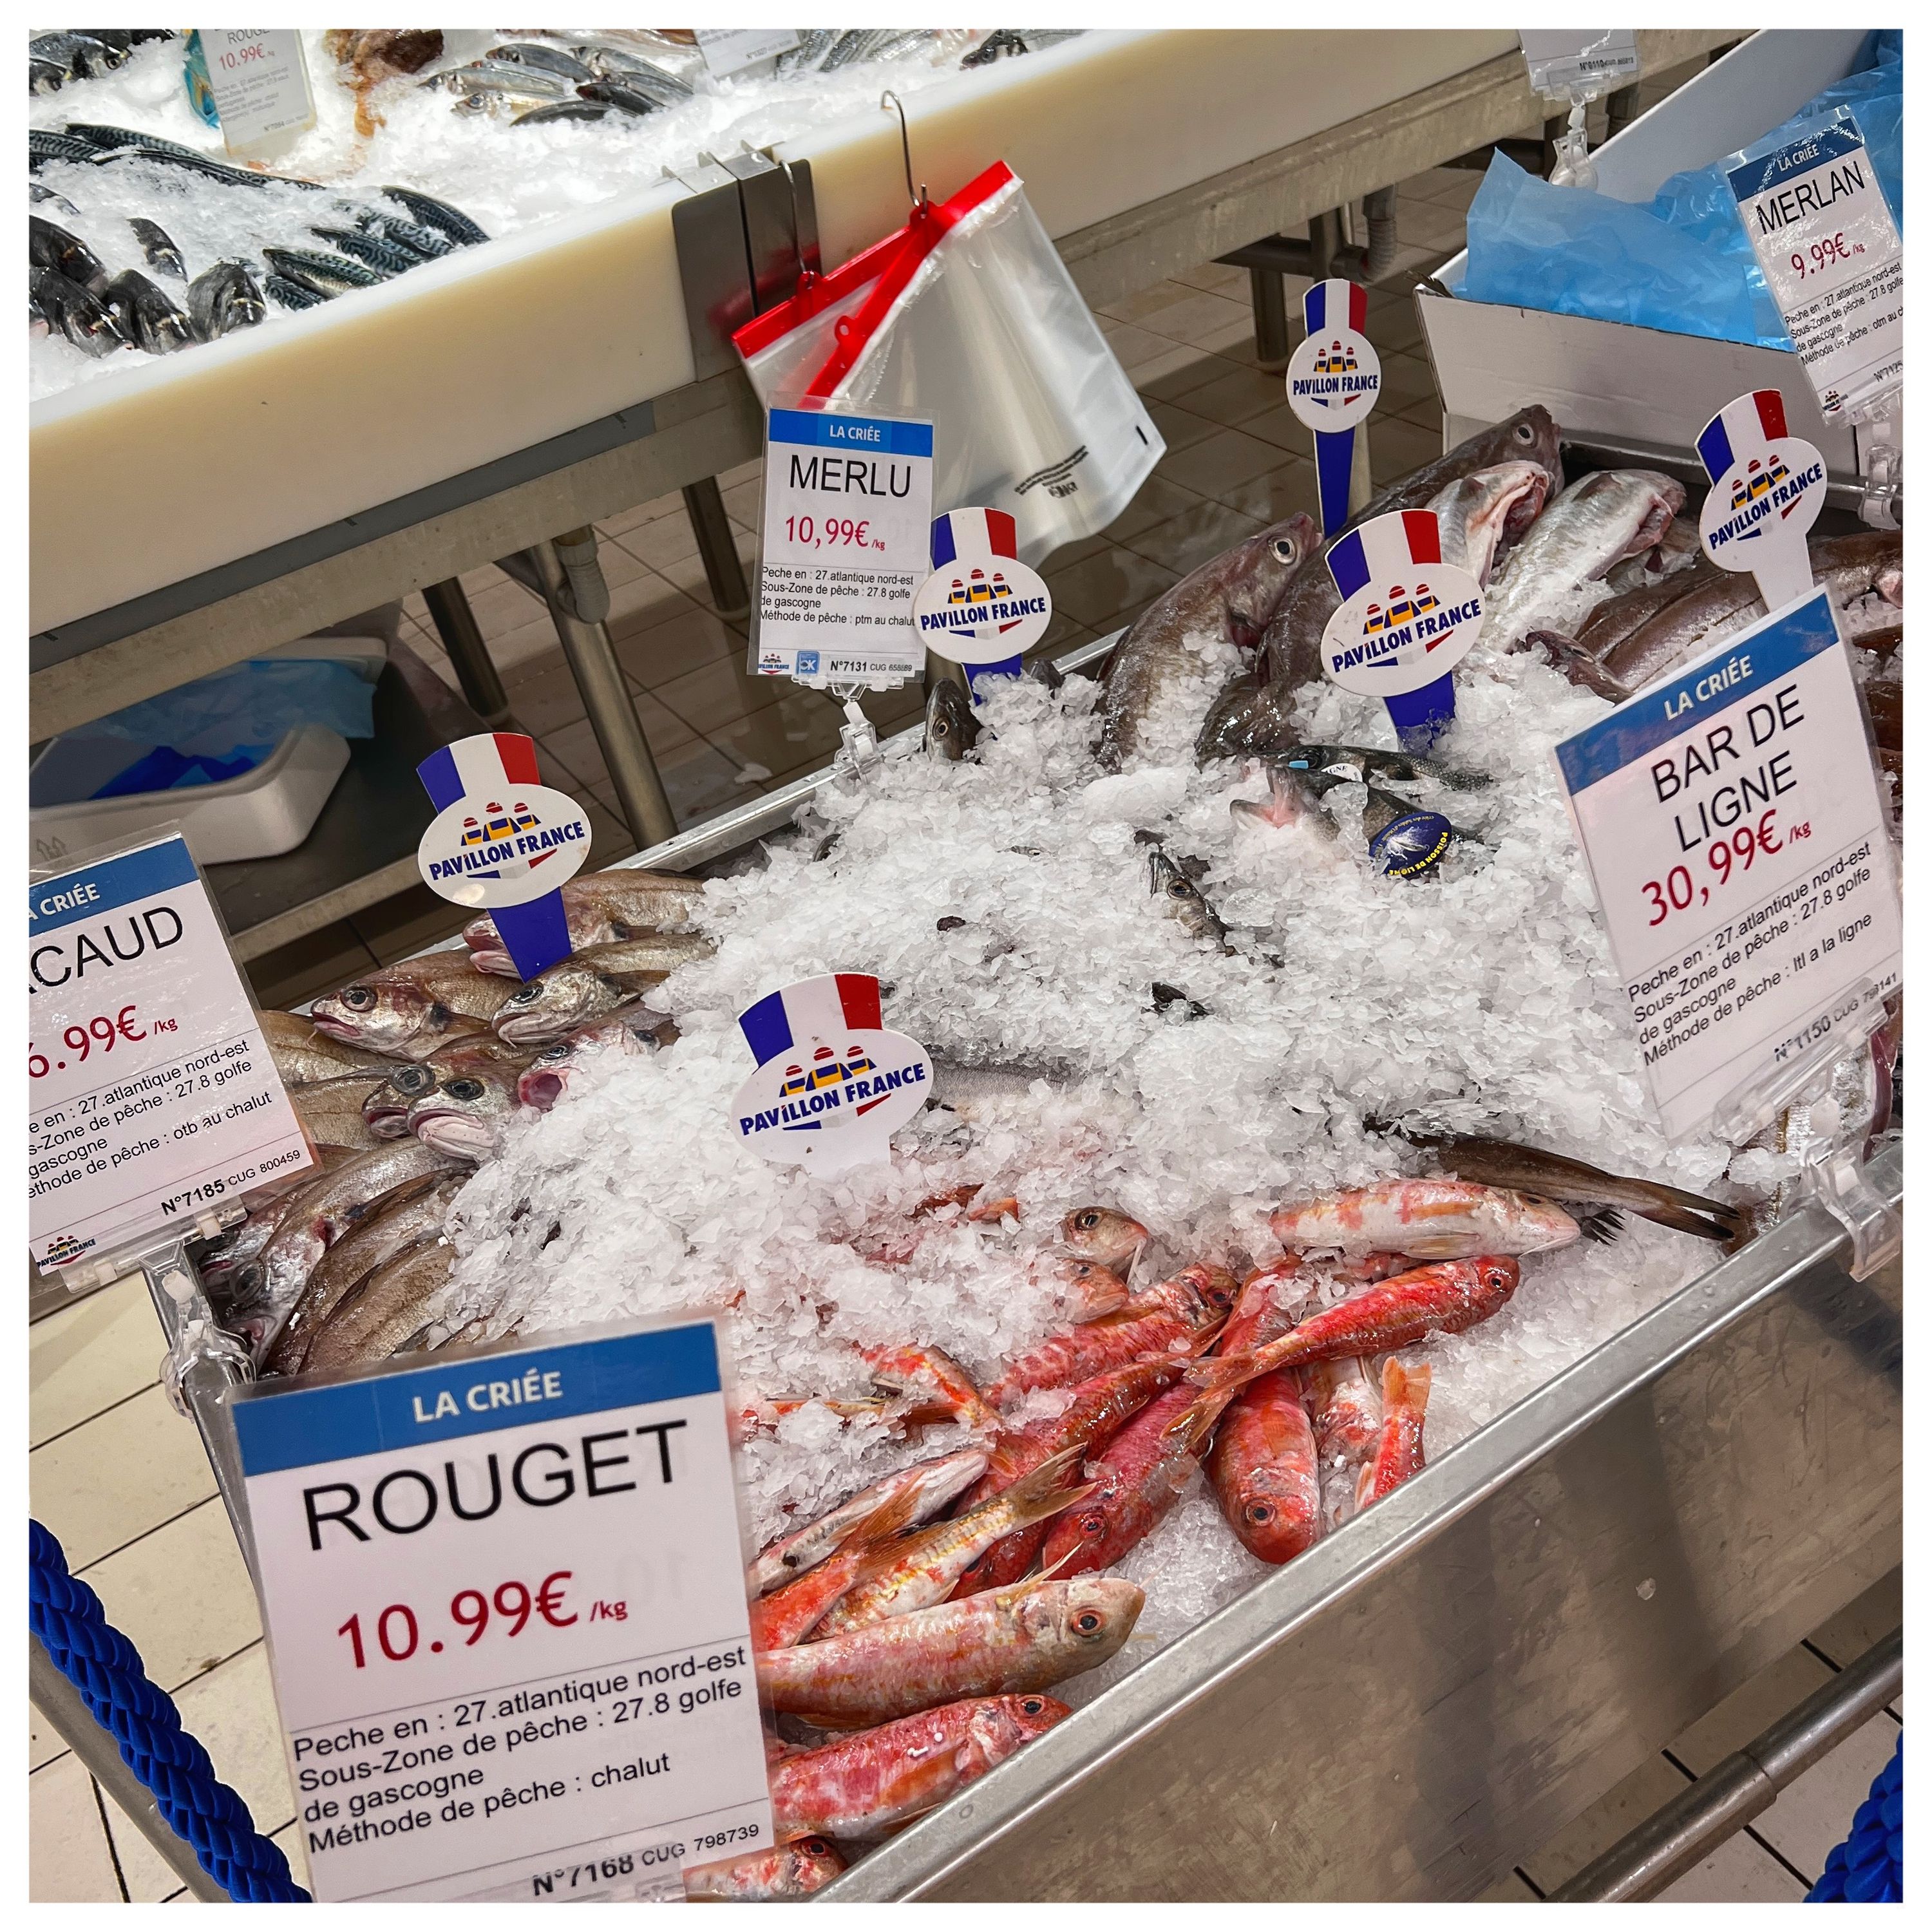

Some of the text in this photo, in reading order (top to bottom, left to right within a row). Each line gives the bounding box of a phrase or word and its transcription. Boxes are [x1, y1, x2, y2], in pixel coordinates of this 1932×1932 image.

[219, 43, 265, 70] 10.99€
[1776, 156, 1793, 171] LA
[1755, 160, 1865, 235] MERLAN
[1791, 232, 1851, 279] 9.99€
[1784, 309, 1810, 327] Peche
[1810, 304, 1821, 314] en
[1871, 261, 1902, 283] nord-est
[1790, 314, 1832, 339] Sous-Zone
[1832, 308, 1842, 319] de
[1842, 297, 1866, 316] pêche
[1869, 284, 1886, 300] 27.8
[1795, 324, 1843, 353] de gascogne
[1800, 344, 1834, 367] Méthode
[1872, 317, 1887, 330] otm
[1887, 312, 1897, 322] au
[1293, 375, 1378, 395] PAVILLON FRANCE
[829, 424, 880, 442] LA CRIÉE
[790, 455, 911, 497] MERLU
[1709, 462, 1823, 550] PAVILLON FRANCE
[786, 515, 886, 551] 10,99€ /kg
[762, 567, 792, 578] Peche
[815, 570, 875, 584] 27.atlantique
[878, 574, 914, 585] nord-est
[762, 581, 911, 600] Sous-Zone de pêche 27.8 golfe
[774, 599, 821, 610] gascogne
[761, 611, 914, 627] Méthode de pêche ptm au chalut
[920, 596, 1046, 631] PAVILLON FRANCE
[1332, 598, 1481, 673] PAVILLON FRANCE
[831, 660, 867, 672] N°7131
[1664, 655, 1753, 721] LA CRIÉE
[1651, 684, 1804, 804] BAR DE
[1674, 750, 1797, 853] LIGNE
[428, 821, 585, 881] PAVILLON FRANCE
[1416, 860, 1427, 871] DE
[1426, 831, 1448, 864] POISSON
[1642, 810, 1812, 926] 30,99€ /kg
[40, 883, 100, 915] CRIÉE
[1628, 841, 1871, 1003] Peche en 27.atlantique nord-est
[30, 905, 184, 994] CAUD
[1634, 868, 1870, 1023] Sous-Zone de pêche 27.8 golfe
[1639, 977, 1736, 1045] de gascogne
[1641, 1018, 1709, 1066] Méthode
[1713, 1001, 1732, 1021] de
[1735, 972, 1781, 1012] pêche
[1810, 948, 1819, 961] a
[1821, 938, 1835, 954] la
[1838, 914, 1871, 943] ligne
[1833, 999, 1859, 1021] CUG
[29, 1005, 178, 1078] 6.99€ /kg
[44, 1112, 66, 1128] en
[78, 1068, 182, 1115] 27.atlantique
[185, 1039, 250, 1074] nord-est
[89, 1116, 110, 1131] de
[113, 1096, 163, 1126] pêche
[175, 1074, 211, 1098] 27.8
[214, 1060, 252, 1086] golfe
[739, 1063, 926, 1136] PAVILLON FRANCE
[29, 1139, 108, 1180] gascogne
[86, 1159, 107, 1175] de
[110, 1139, 160, 1168] pêche
[173, 1121, 198, 1140] otb
[202, 1113, 222, 1128] au
[225, 1091, 272, 1119] chalut
[160, 1150, 300, 1216] N°7185 CUG 800459
[70, 1238, 96, 1253] FRANCE
[413, 1368, 562, 1422] LA CRIÉE
[303, 1419, 687, 1551] ROUGET
[338, 1571, 629, 1669] 10.99€ /kg
[294, 1645, 746, 1762] Peche en 27.atlantique nord-est
[299, 1678, 742, 1792] Sous-Zone de pêche 27.8 golfe
[304, 1769, 484, 1823] de gascogne
[308, 1753, 670, 1854] Méthode de pêche chalut
[533, 1824, 759, 1897] N°7168 CUG 798739
